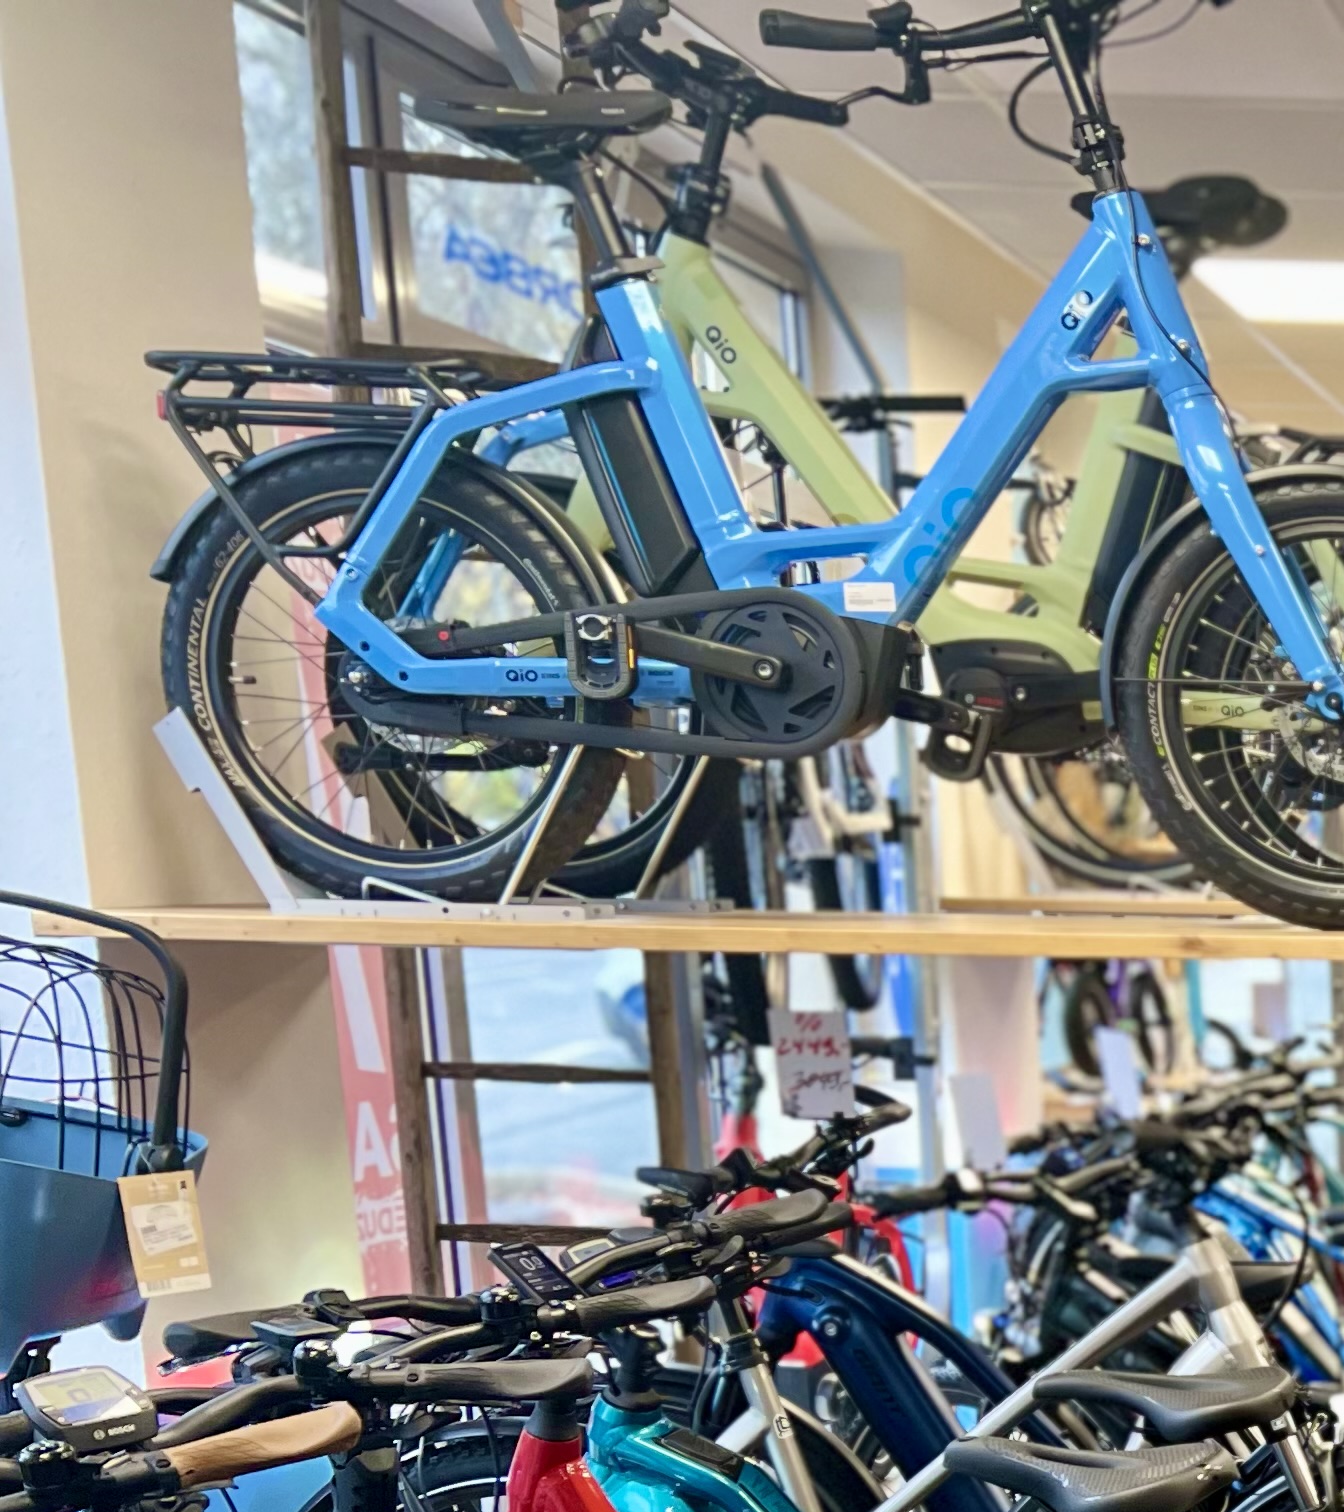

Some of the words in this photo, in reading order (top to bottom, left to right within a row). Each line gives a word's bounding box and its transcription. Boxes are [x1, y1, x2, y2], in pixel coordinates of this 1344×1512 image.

[705, 325, 737, 364] QiO
[186, 597, 212, 732] CONTINENTAL
[505, 669, 538, 682] QiO
